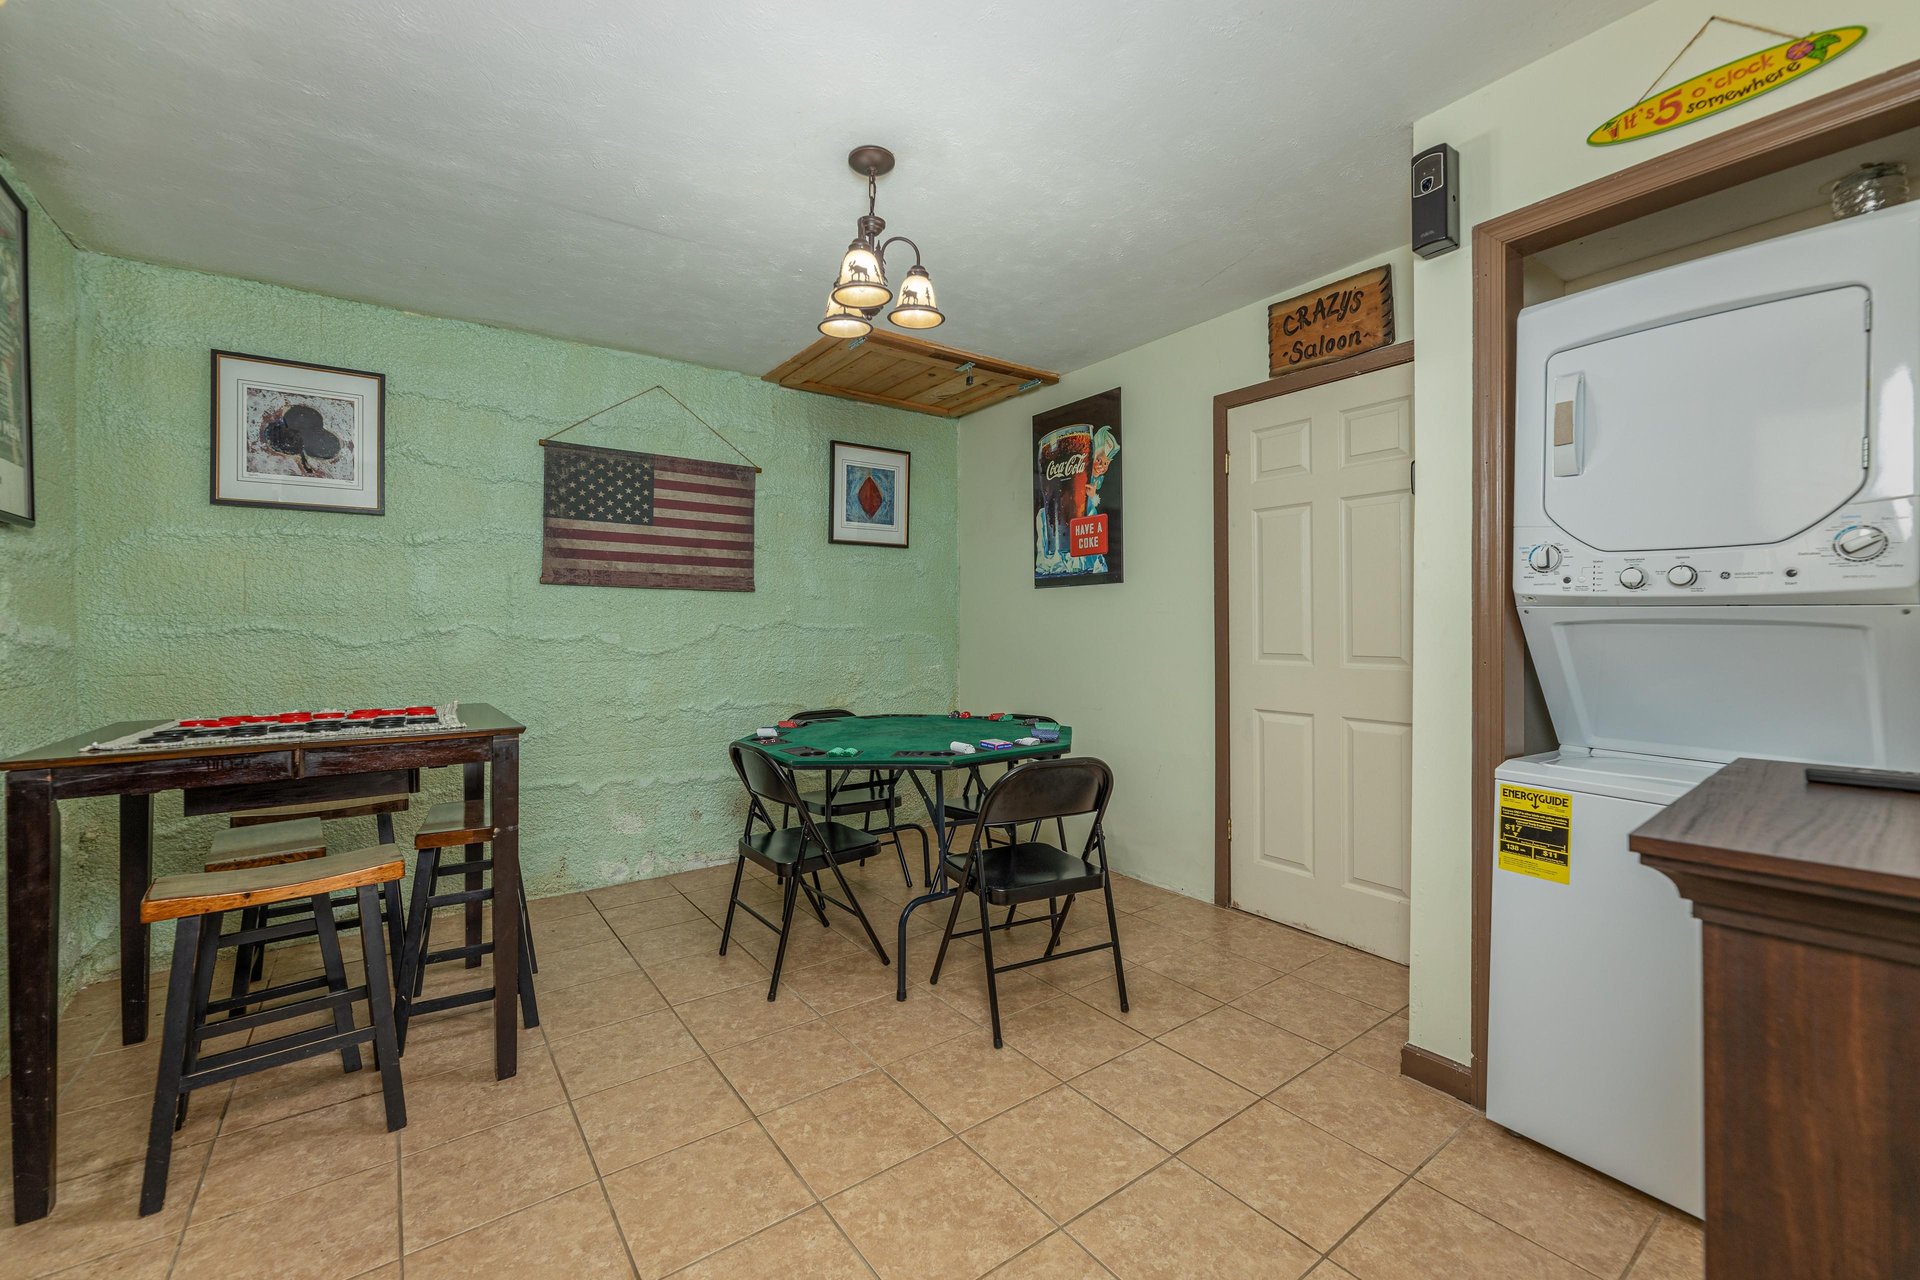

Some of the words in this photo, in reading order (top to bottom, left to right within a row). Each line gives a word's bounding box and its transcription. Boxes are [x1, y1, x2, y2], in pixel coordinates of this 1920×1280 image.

[1623, 108, 1656, 130] It's
[1653, 90, 1684, 126] 5
[1691, 54, 1775, 99] o'clock
[1686, 61, 1801, 114] somewhere
[1046, 453, 1088, 481] Coca-Cola
[1075, 522, 1095, 537] HAVE
[1097, 521, 1103, 533] A
[1078, 536, 1099, 550] COKE
[1502, 788, 1569, 809] ENERGYGUIDE
[1504, 823, 1522, 833] $17
